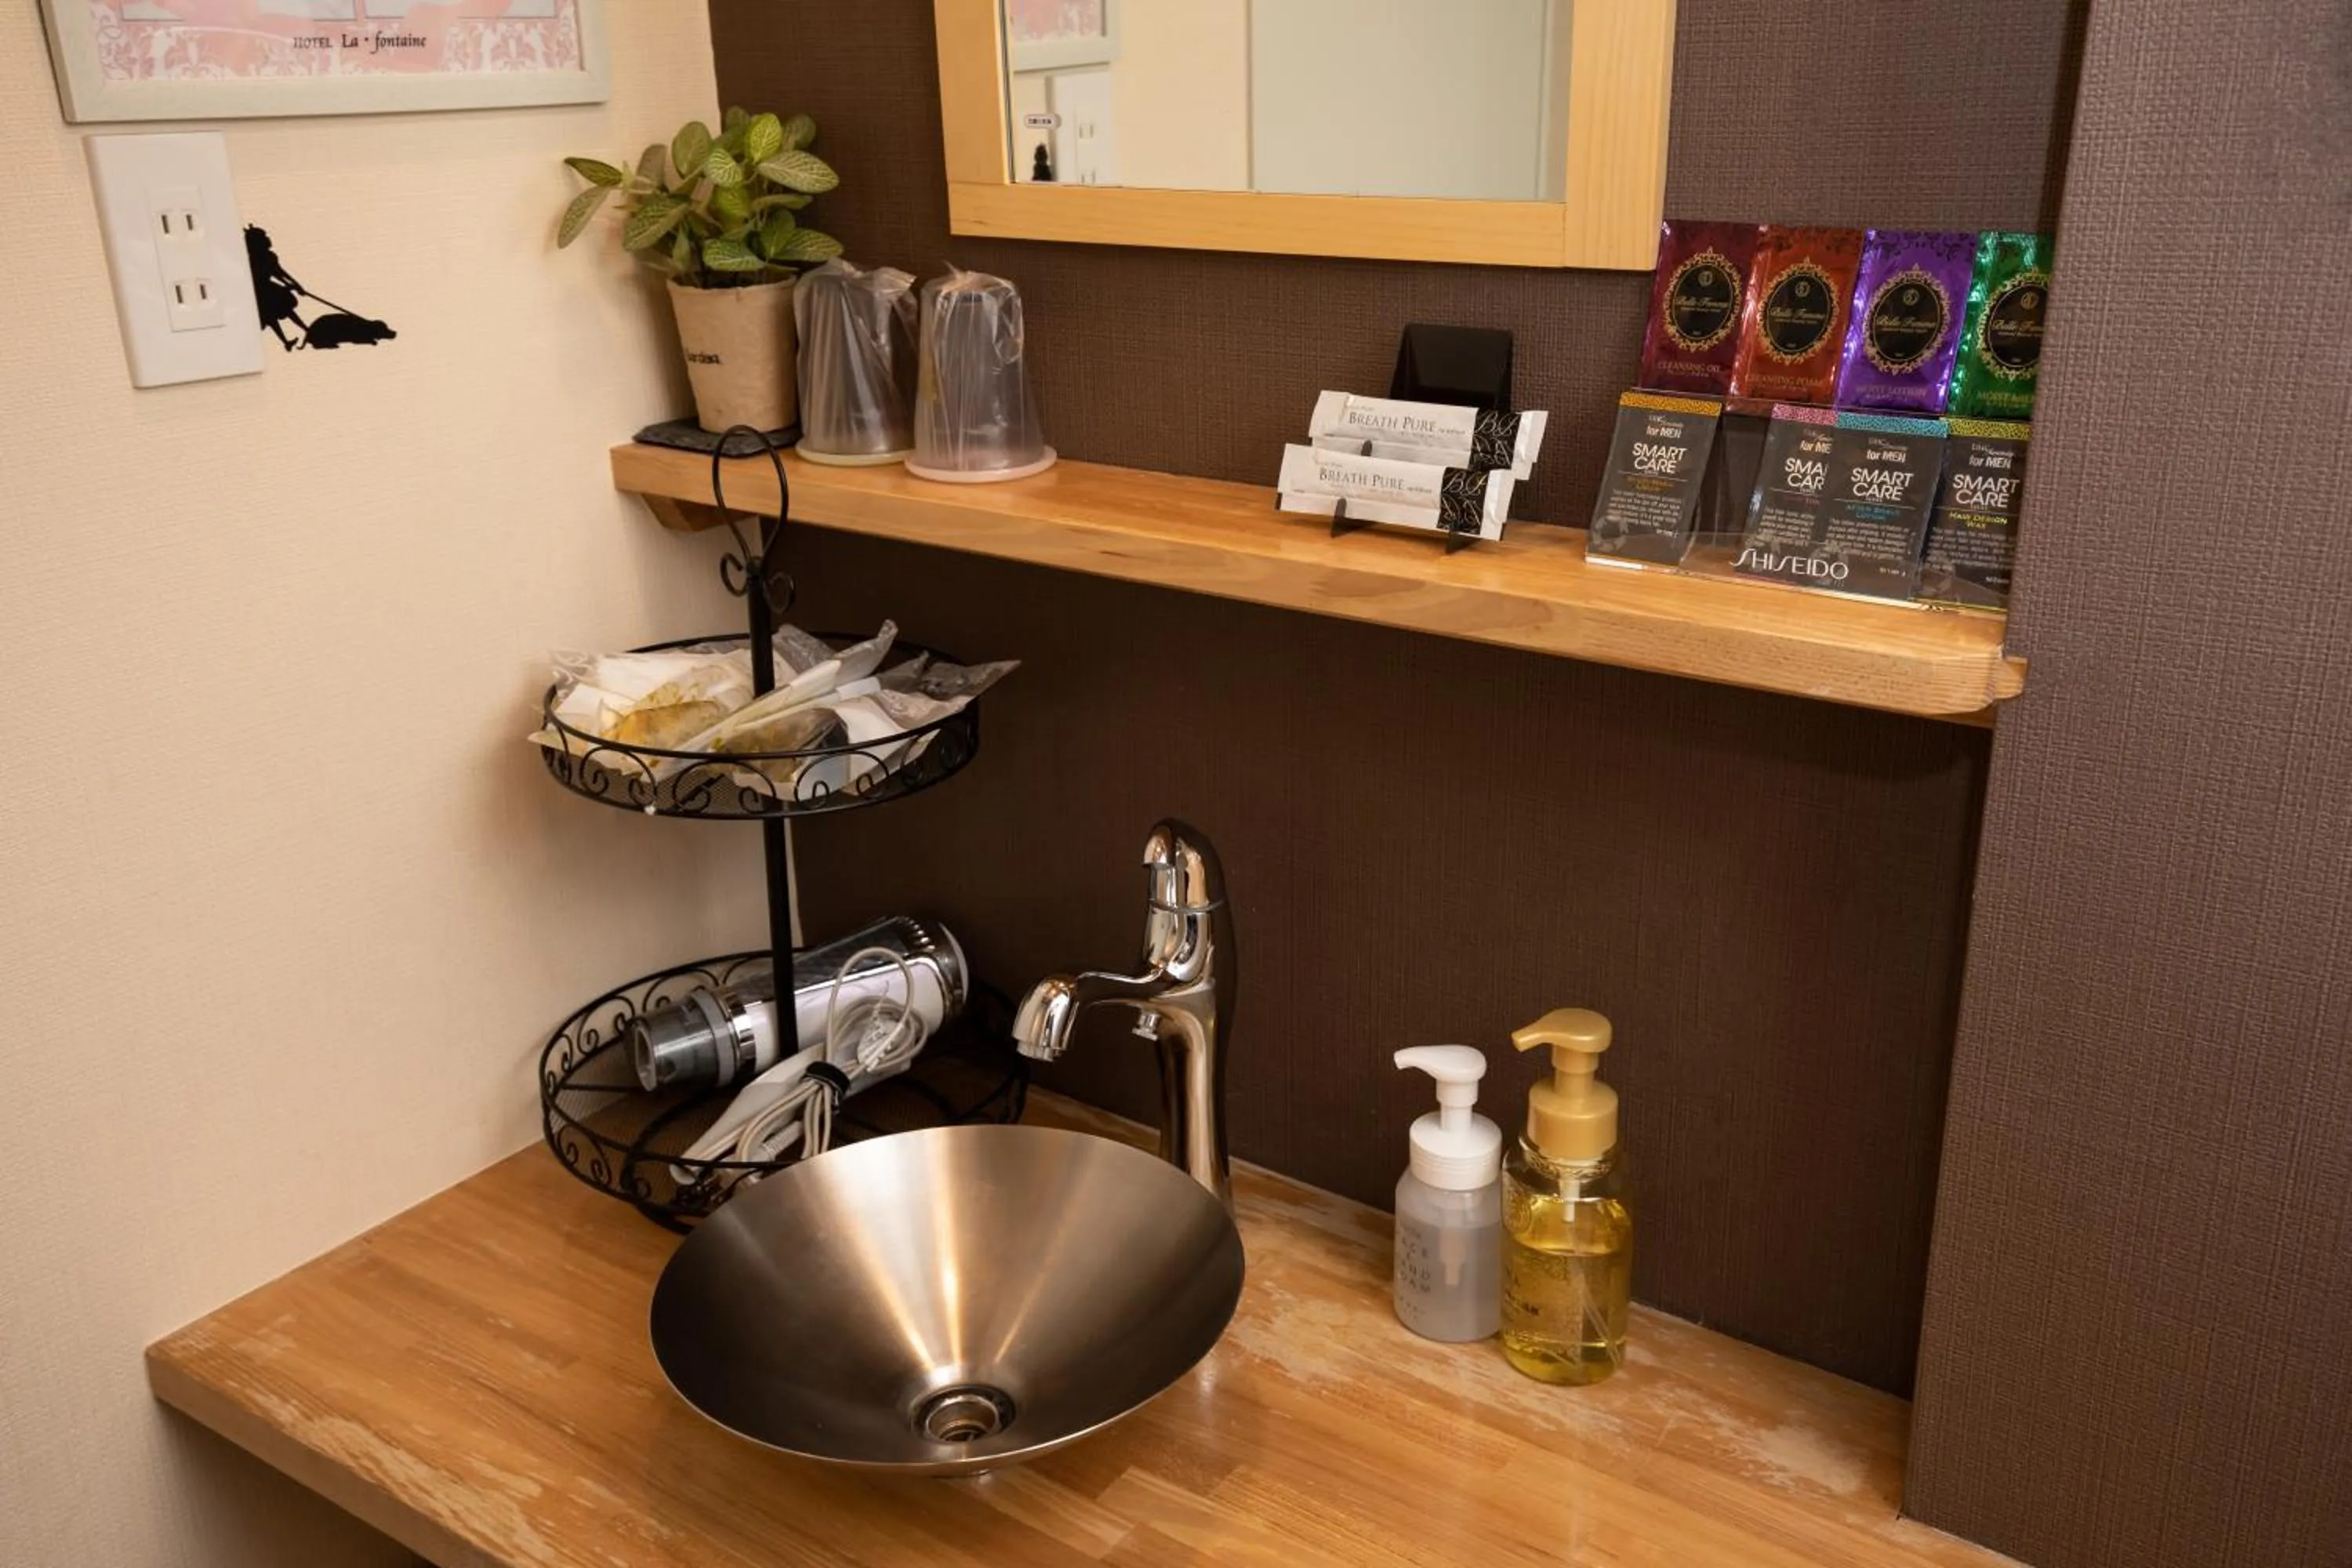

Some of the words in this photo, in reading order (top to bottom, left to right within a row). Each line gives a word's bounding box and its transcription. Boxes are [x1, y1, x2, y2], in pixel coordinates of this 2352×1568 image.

[293, 36, 333, 49] HOTEL
[342, 34, 358, 48] La
[369, 30, 426, 55] fontaine
[1348, 412, 1398, 429] BREATH
[1402, 416, 1436, 432] PURE
[1646, 426, 1659, 436] for
[1660, 427, 1682, 438] MEN
[1632, 442, 1687, 461] SMART
[1799, 440, 1814, 452] for
[1815, 441, 1832, 454] ME
[1867, 449, 1881, 461] for
[1882, 450, 1907, 463] MEN
[1634, 456, 1676, 474] CARE
[1784, 457, 1829, 476] SMA
[1969, 454, 1984, 466] for
[1984, 456, 2013, 469] MEN
[1319, 466, 1368, 485] BREATH
[1372, 474, 1405, 490] PURE
[1787, 473, 1826, 490] CAR
[1850, 466, 1914, 488] SMART
[1952, 474, 2020, 494] SMART
[1853, 482, 1904, 501] CARE
[1955, 488, 2009, 507] CARE
[1730, 548, 1849, 579] SHISEIDO
